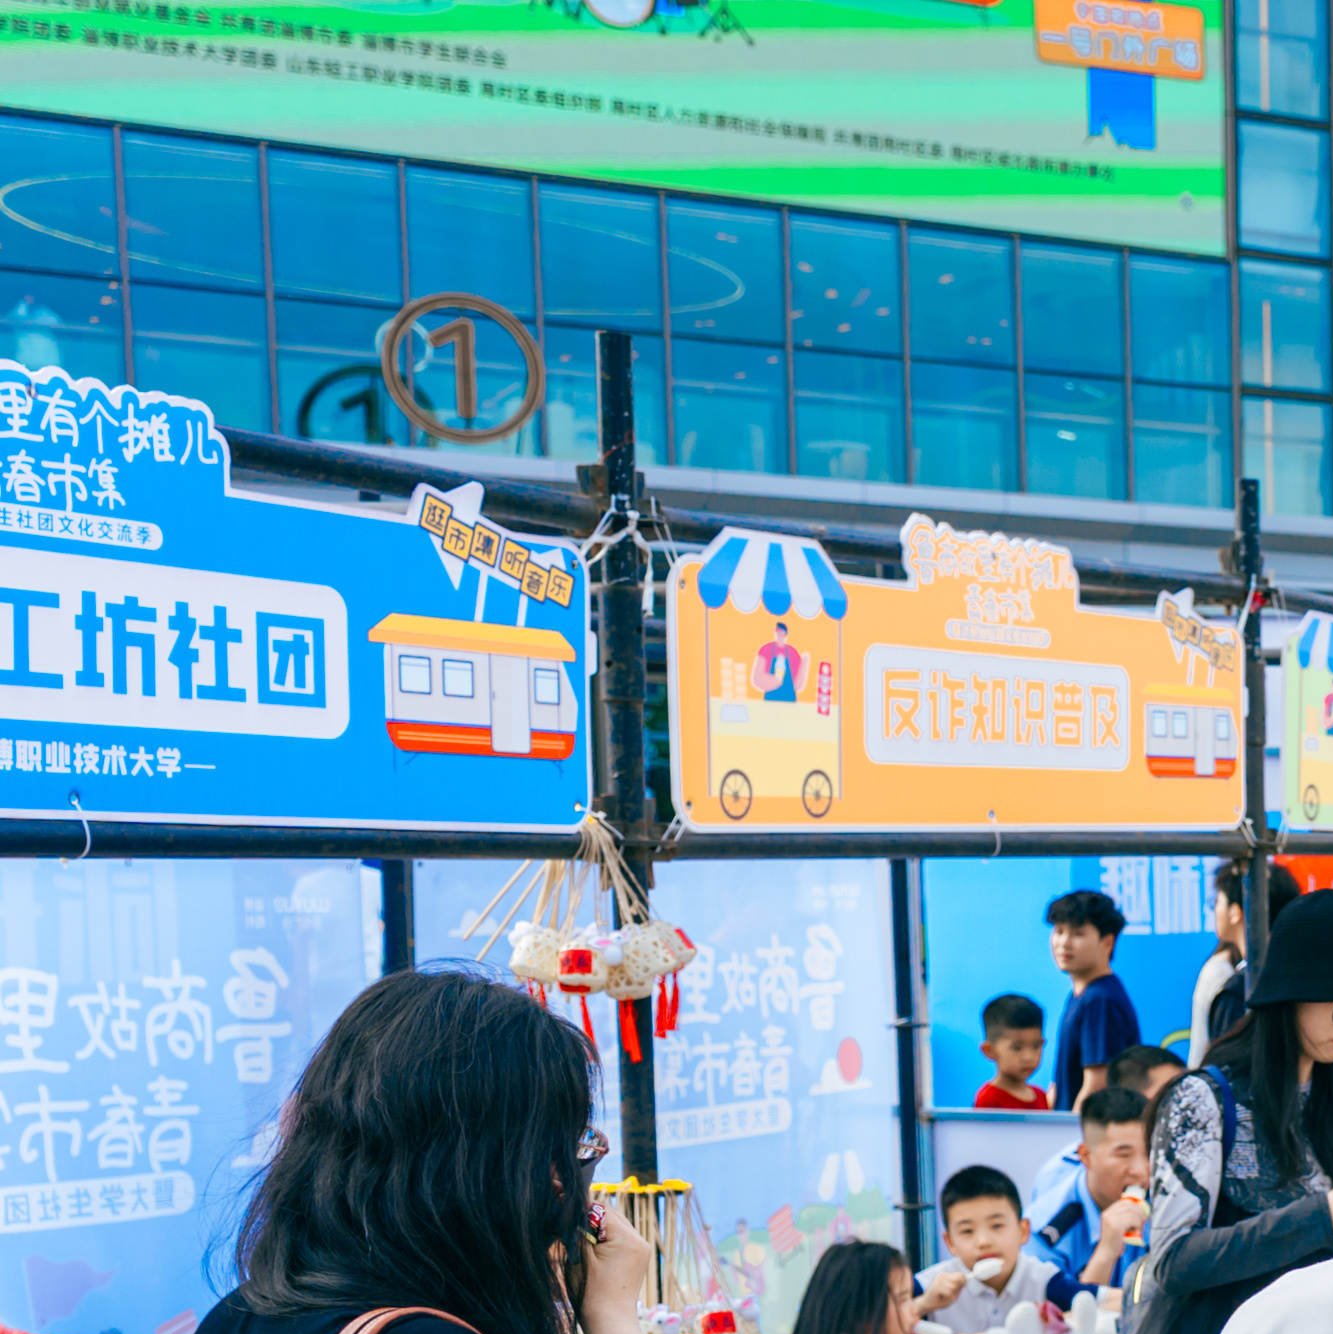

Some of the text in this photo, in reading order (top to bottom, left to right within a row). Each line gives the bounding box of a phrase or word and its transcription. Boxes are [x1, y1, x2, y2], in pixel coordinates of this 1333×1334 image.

[0, 449, 126, 511] 春市集
[0, 586, 328, 709] 工坊社团
[881, 668, 1121, 751] 反诈知识普及
